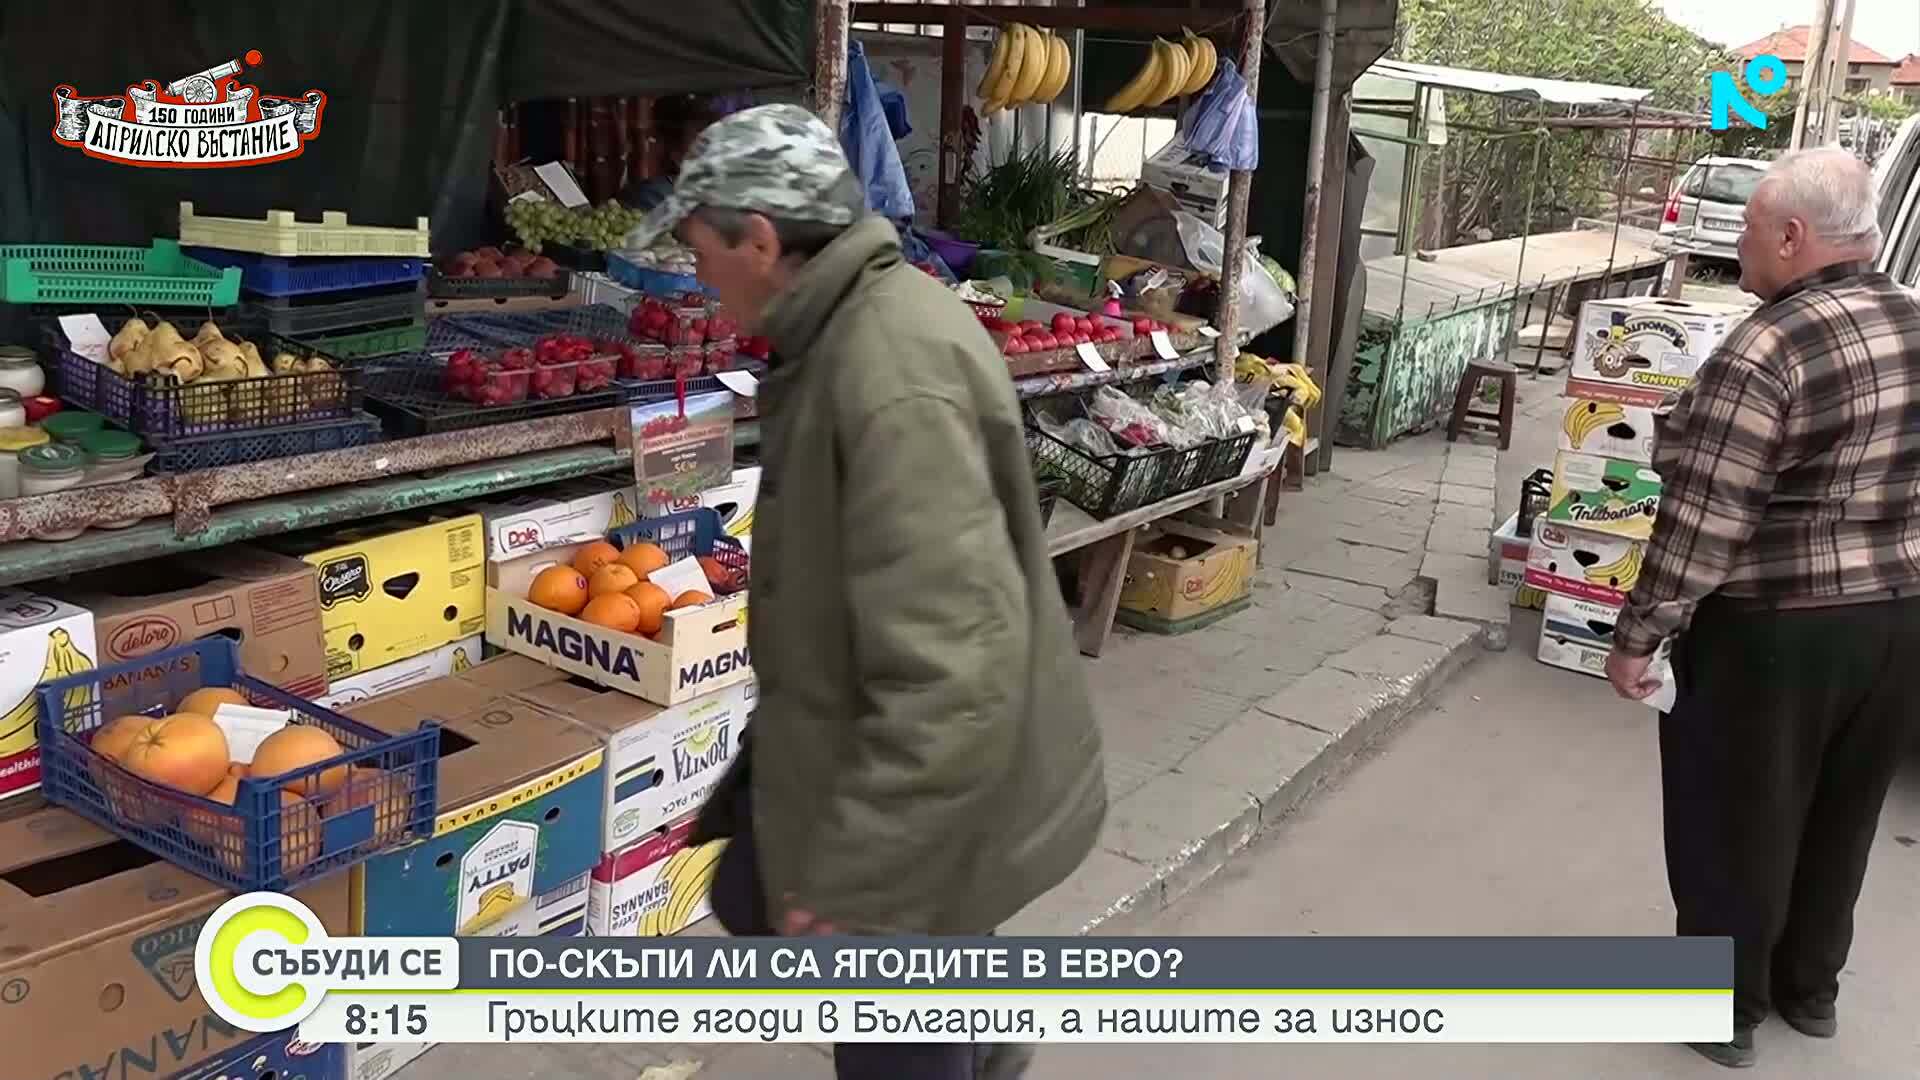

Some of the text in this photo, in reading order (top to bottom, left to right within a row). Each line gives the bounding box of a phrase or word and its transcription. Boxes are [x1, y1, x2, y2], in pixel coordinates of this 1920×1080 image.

[507, 527, 539, 547] Dole
[120, 621, 170, 654] deloro
[679, 647, 753, 690] MAGN
[672, 723, 730, 783] BONITA
[511, 765, 585, 804] PREMIUM
[468, 852, 531, 893] PATTY
[612, 880, 669, 920] BANANAS
